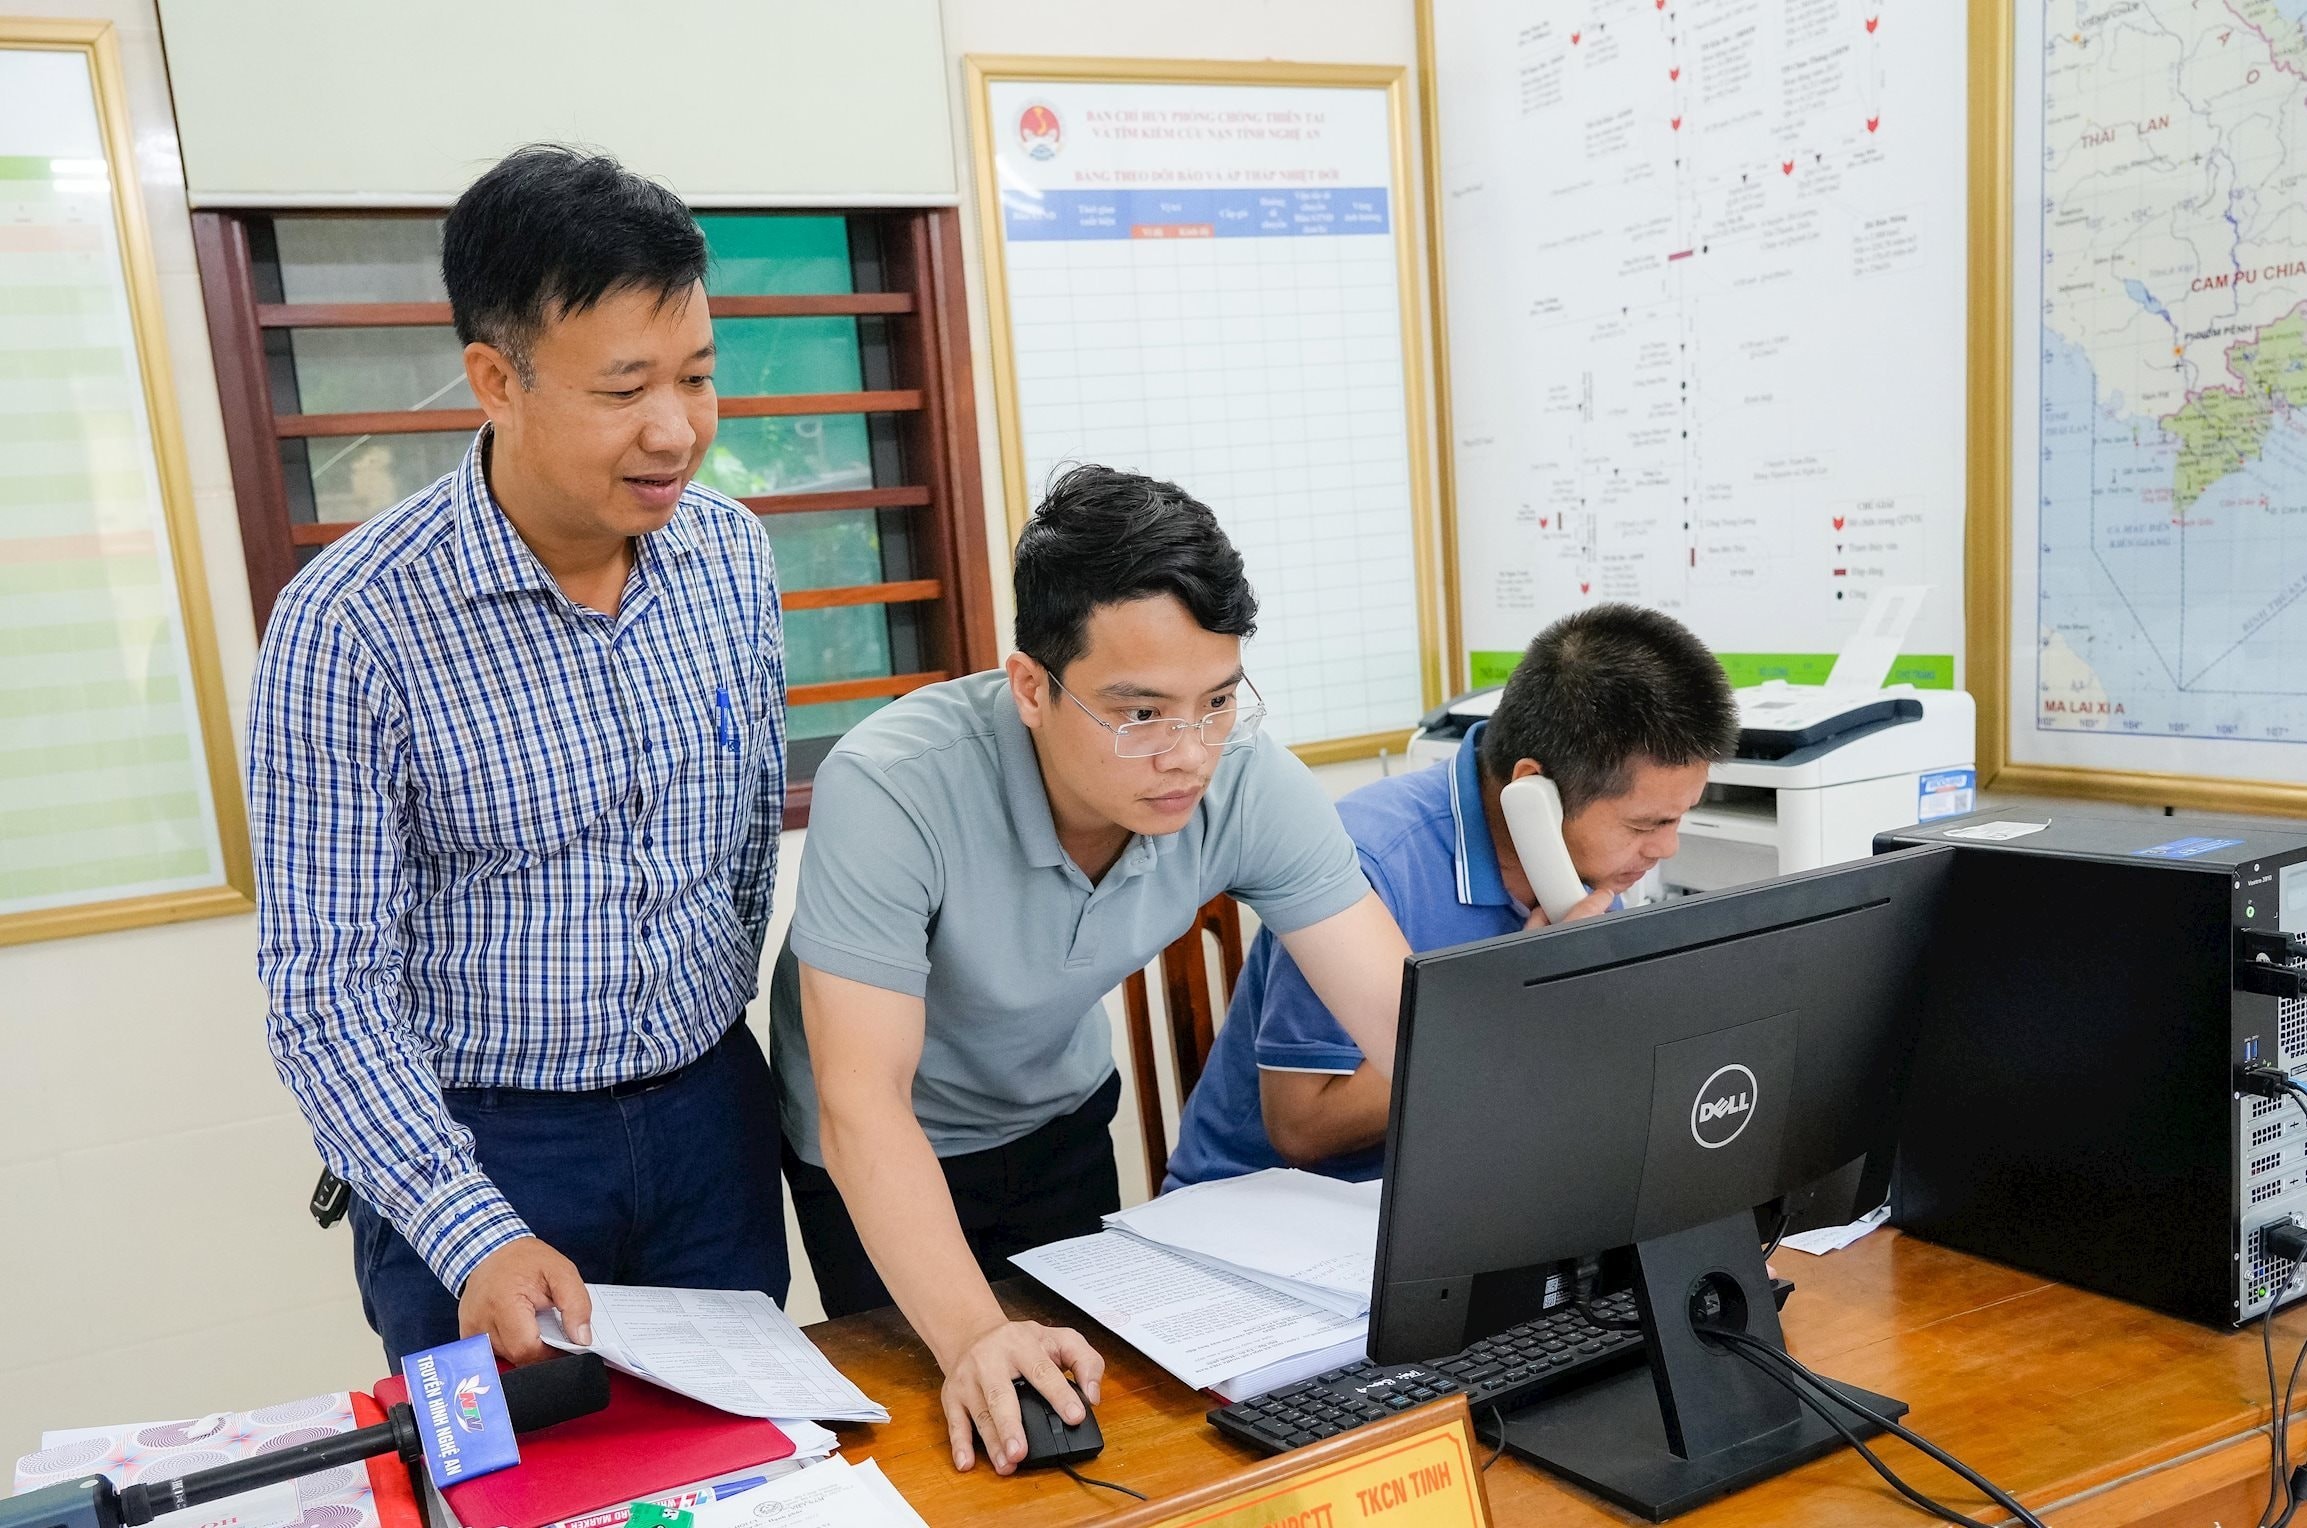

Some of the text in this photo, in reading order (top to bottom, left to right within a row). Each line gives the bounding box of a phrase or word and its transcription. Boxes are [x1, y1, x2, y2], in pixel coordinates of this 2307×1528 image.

[2191, 261, 2307, 293] CAM PU CHIA
[1699, 1092, 1750, 1123] DELL
[417, 1354, 462, 1476] TRUYỀN HÌNH NGHỆ AN
[458, 1392, 484, 1431] NTV
[1356, 1477, 1409, 1518] TKCN
